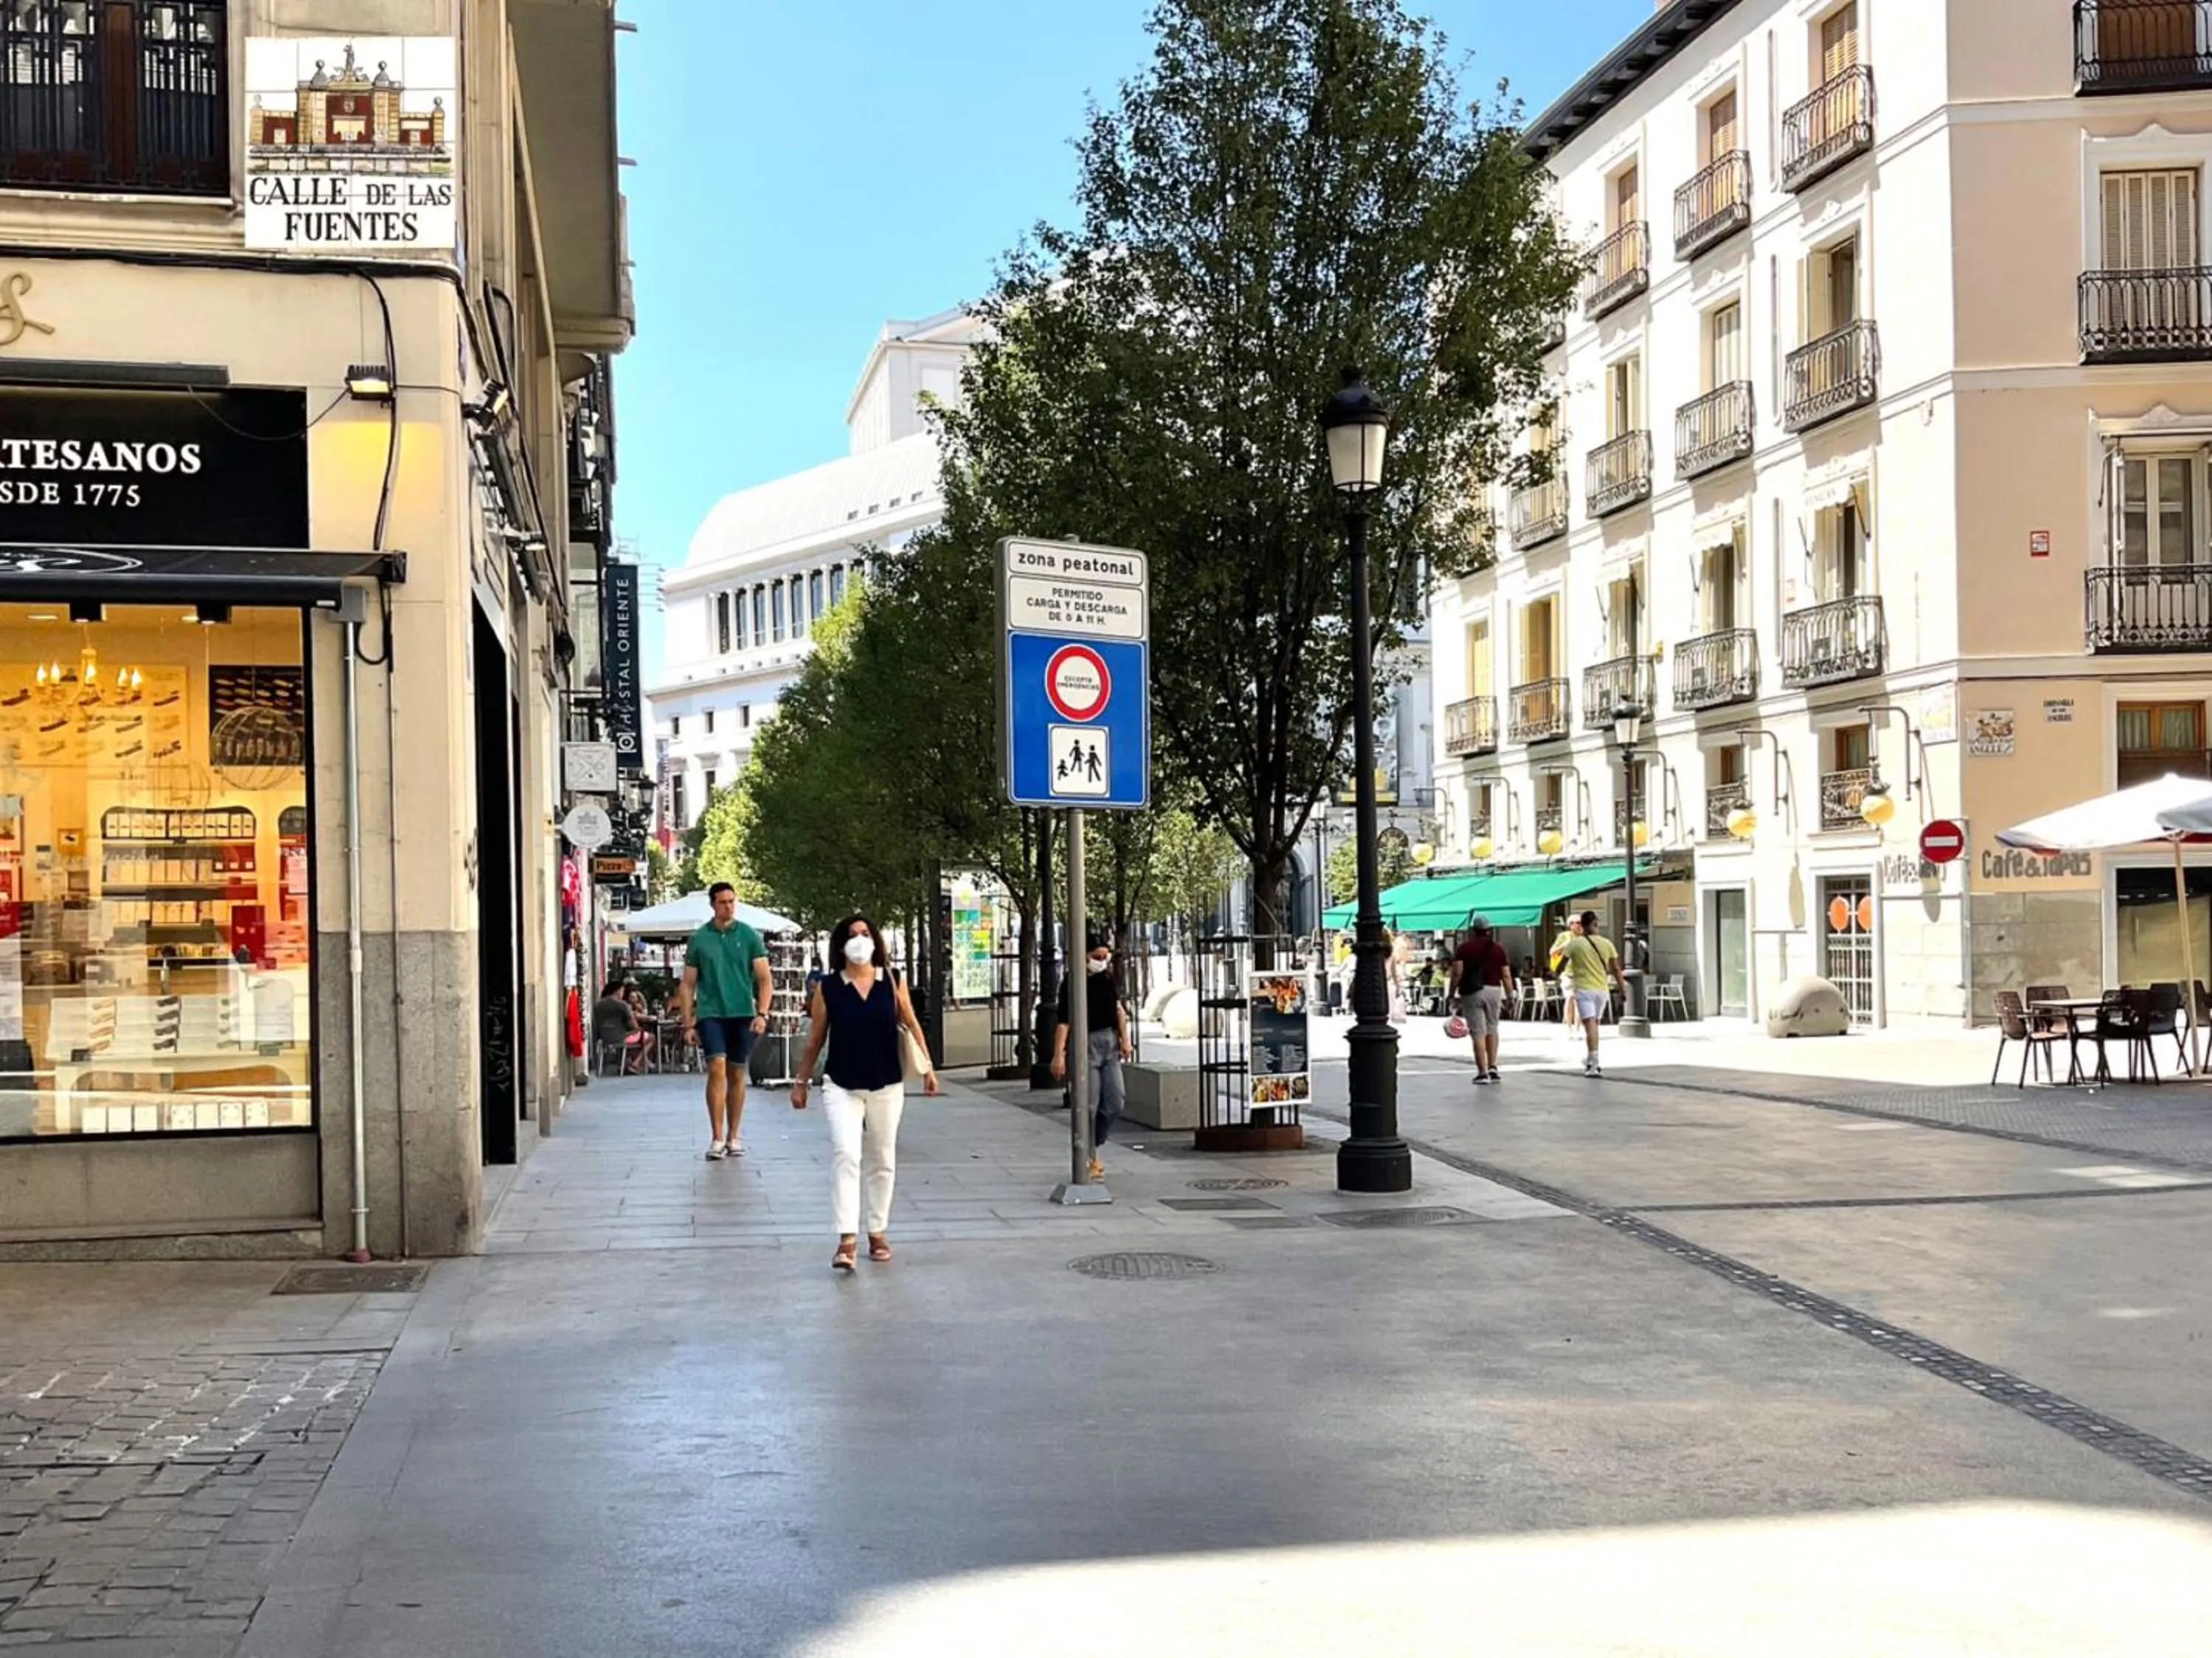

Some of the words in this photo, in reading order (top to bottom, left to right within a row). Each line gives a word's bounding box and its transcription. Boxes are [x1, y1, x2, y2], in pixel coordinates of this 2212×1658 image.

[249, 177, 347, 205] CALLE
[366, 184, 396, 205] DE
[408, 184, 451, 206] LAS
[285, 212, 418, 241] FUENTES
[74, 484, 141, 507] 1775
[1018, 552, 1055, 567] zona
[1062, 556, 1133, 575] peatonal
[1026, 597, 1061, 609] CARGA
[1065, 601, 1071, 610] Y
[1074, 602, 1127, 614] DESCARGA
[1052, 588, 1103, 601] PERMITIDO
[617, 578, 630, 651] ORIENTE
[1048, 611, 1062, 621] DE
[1076, 614, 1083, 622] A
